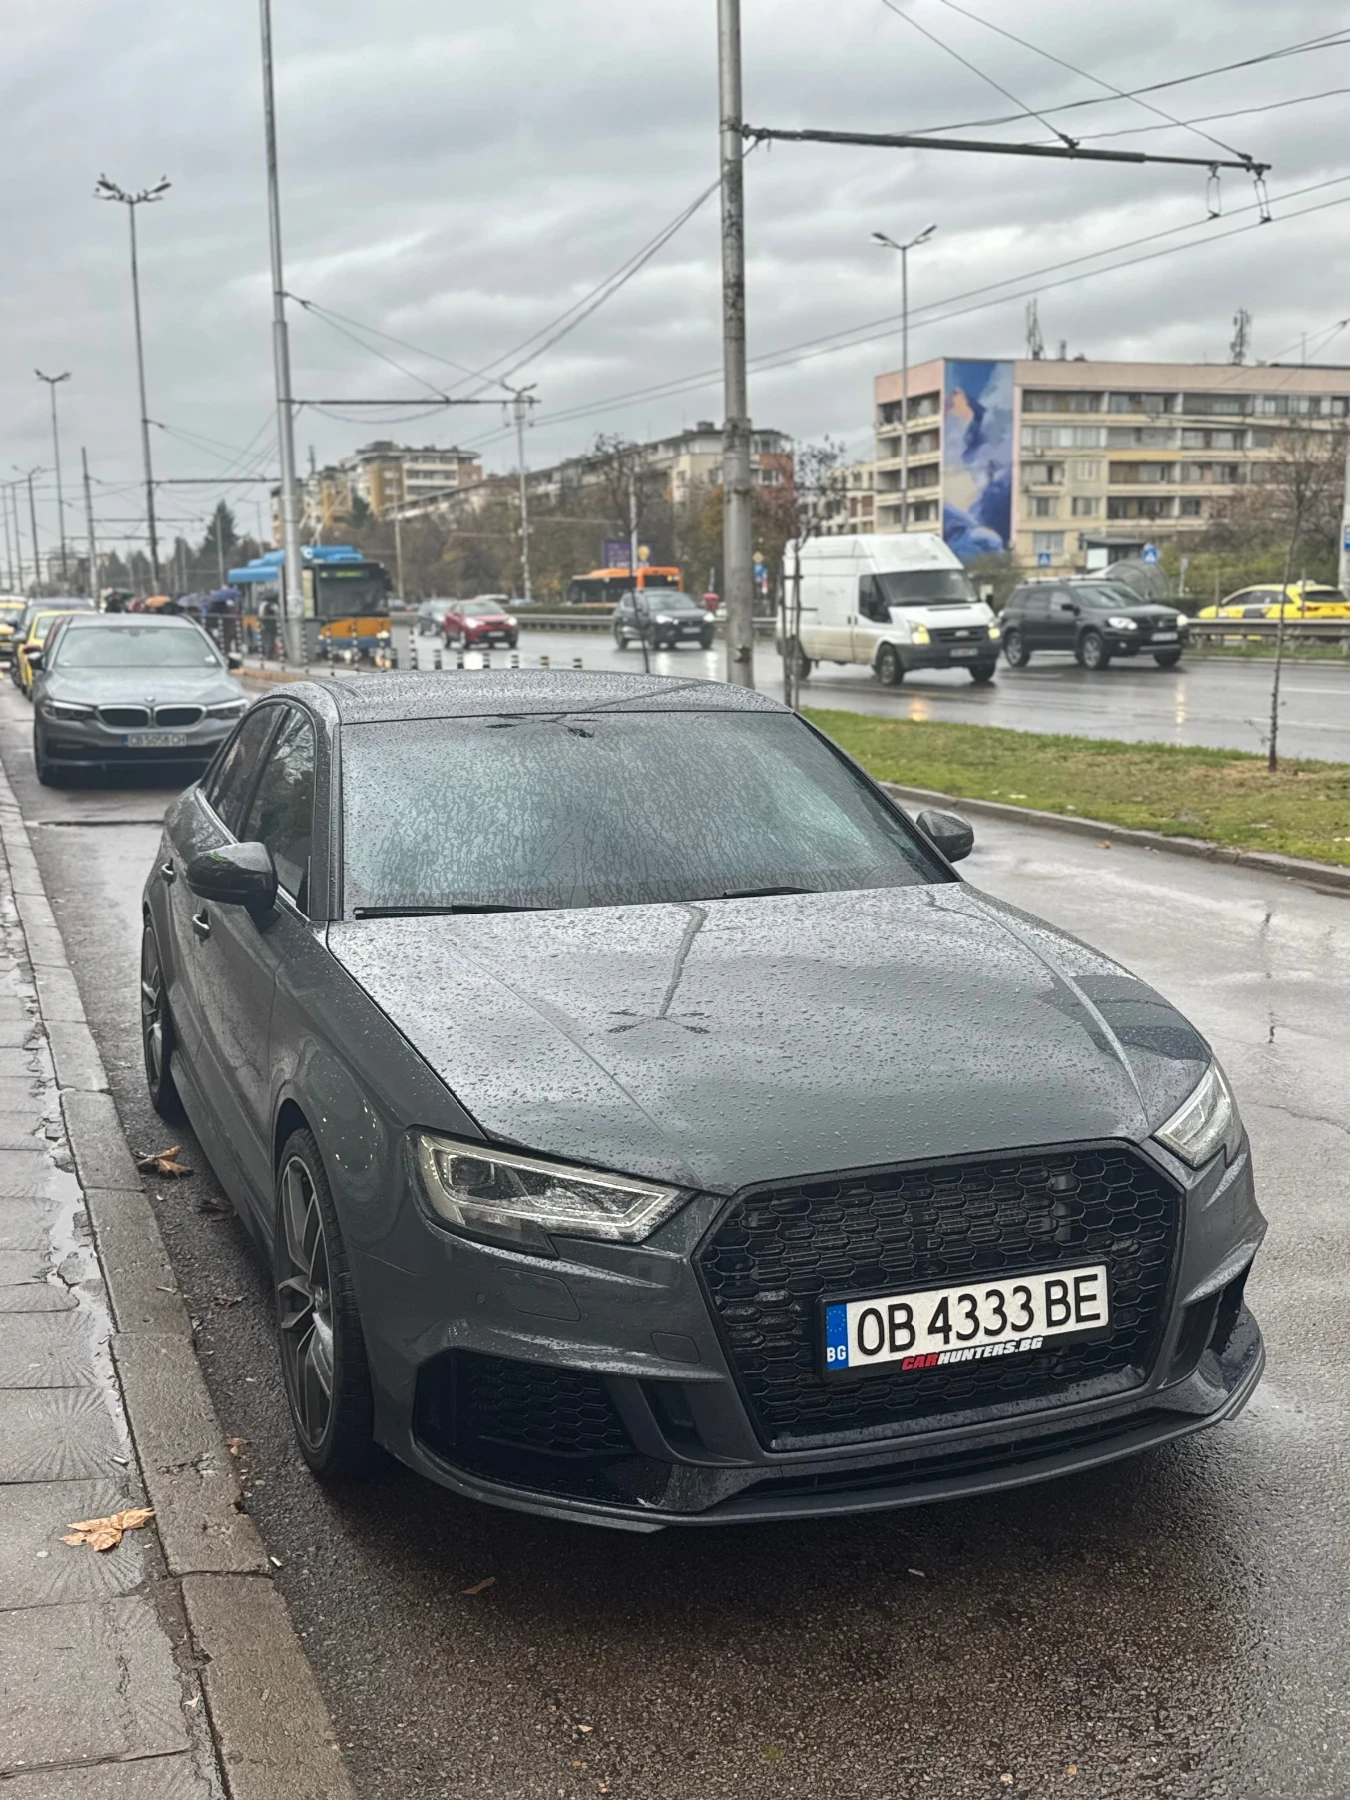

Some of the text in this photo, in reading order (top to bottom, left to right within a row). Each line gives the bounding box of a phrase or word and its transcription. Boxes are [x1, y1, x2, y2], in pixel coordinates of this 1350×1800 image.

[857, 1273, 1101, 1356] OB 4333 BE
[827, 1345, 847, 1363] BG
[901, 1336, 1043, 1371] CARHUNTERS.BG
